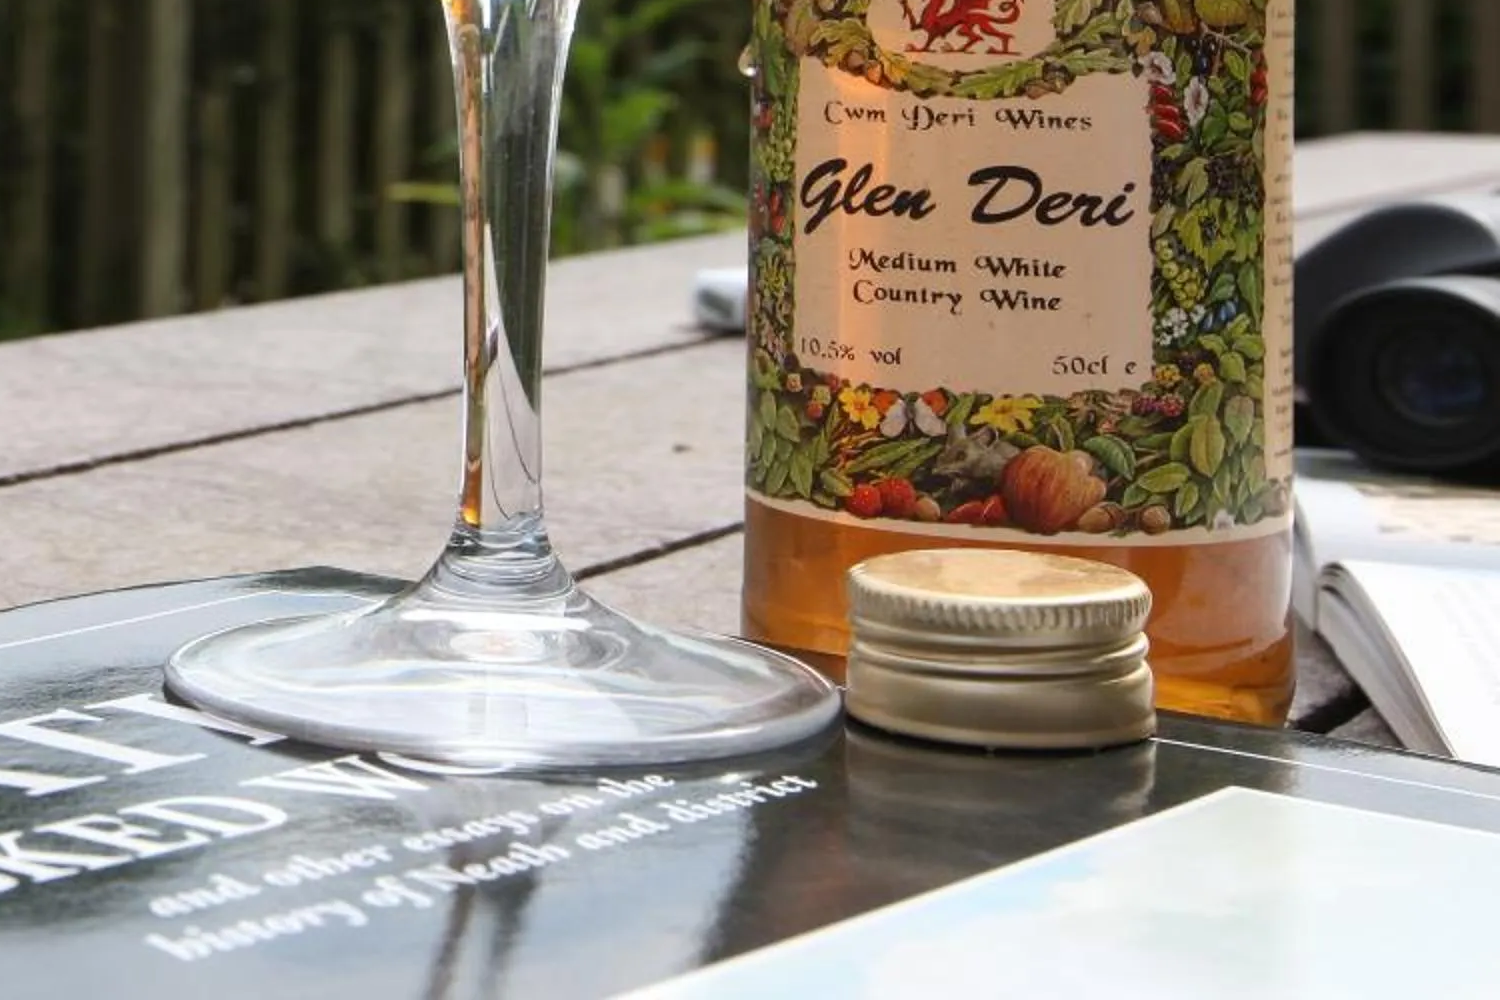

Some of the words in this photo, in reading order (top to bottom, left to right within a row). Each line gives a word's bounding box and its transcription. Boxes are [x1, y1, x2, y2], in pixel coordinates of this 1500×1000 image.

[823, 100, 887, 125] Cwm
[901, 104, 977, 131] Deri
[994, 106, 1093, 130] Wines
[800, 157, 937, 235] Glen
[966, 164, 1137, 227] Deri
[848, 247, 957, 273] Medium
[973, 255, 1068, 278] White
[852, 279, 963, 316] Country
[978, 287, 1062, 311] Wine
[800, 336, 856, 362] 10.5%
[869, 346, 902, 366] vol
[1051, 354, 1108, 375] 50cl
[149, 873, 263, 918] and
[261, 845, 394, 887] other
[402, 810, 541, 851] essays
[537, 792, 604, 816] on
[595, 774, 675, 800] the
[143, 900, 369, 962] history
[361, 875, 435, 909] of
[403, 841, 572, 893] Neath
[575, 811, 672, 852] and
[657, 774, 819, 824] district
